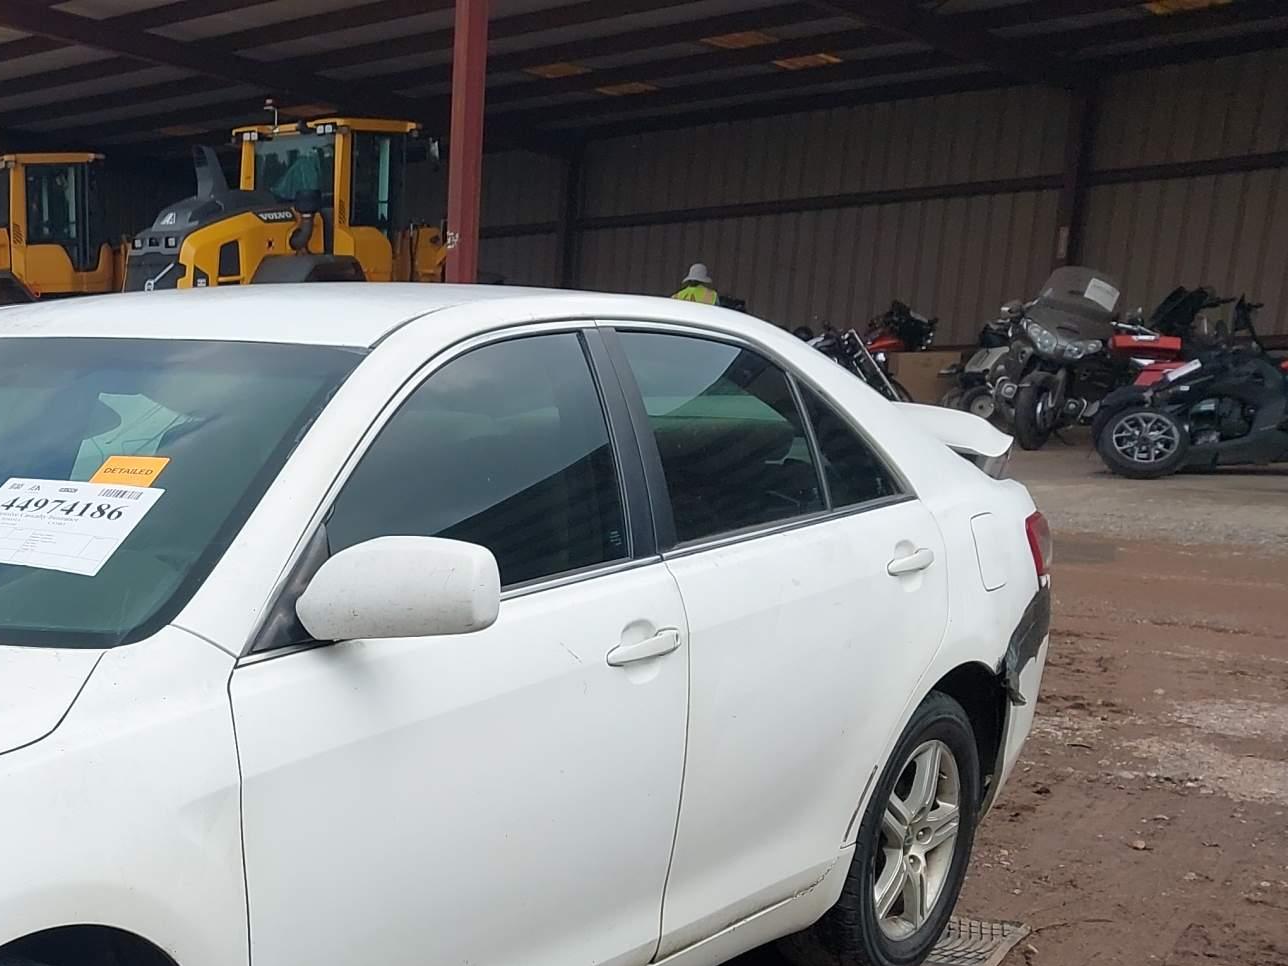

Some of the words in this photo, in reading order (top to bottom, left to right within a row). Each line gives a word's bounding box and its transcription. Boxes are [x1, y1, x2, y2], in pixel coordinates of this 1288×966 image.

[259, 211, 293, 221] VOLVO
[103, 467, 154, 476] DETAILED
[1, 496, 129, 521] 44974186
